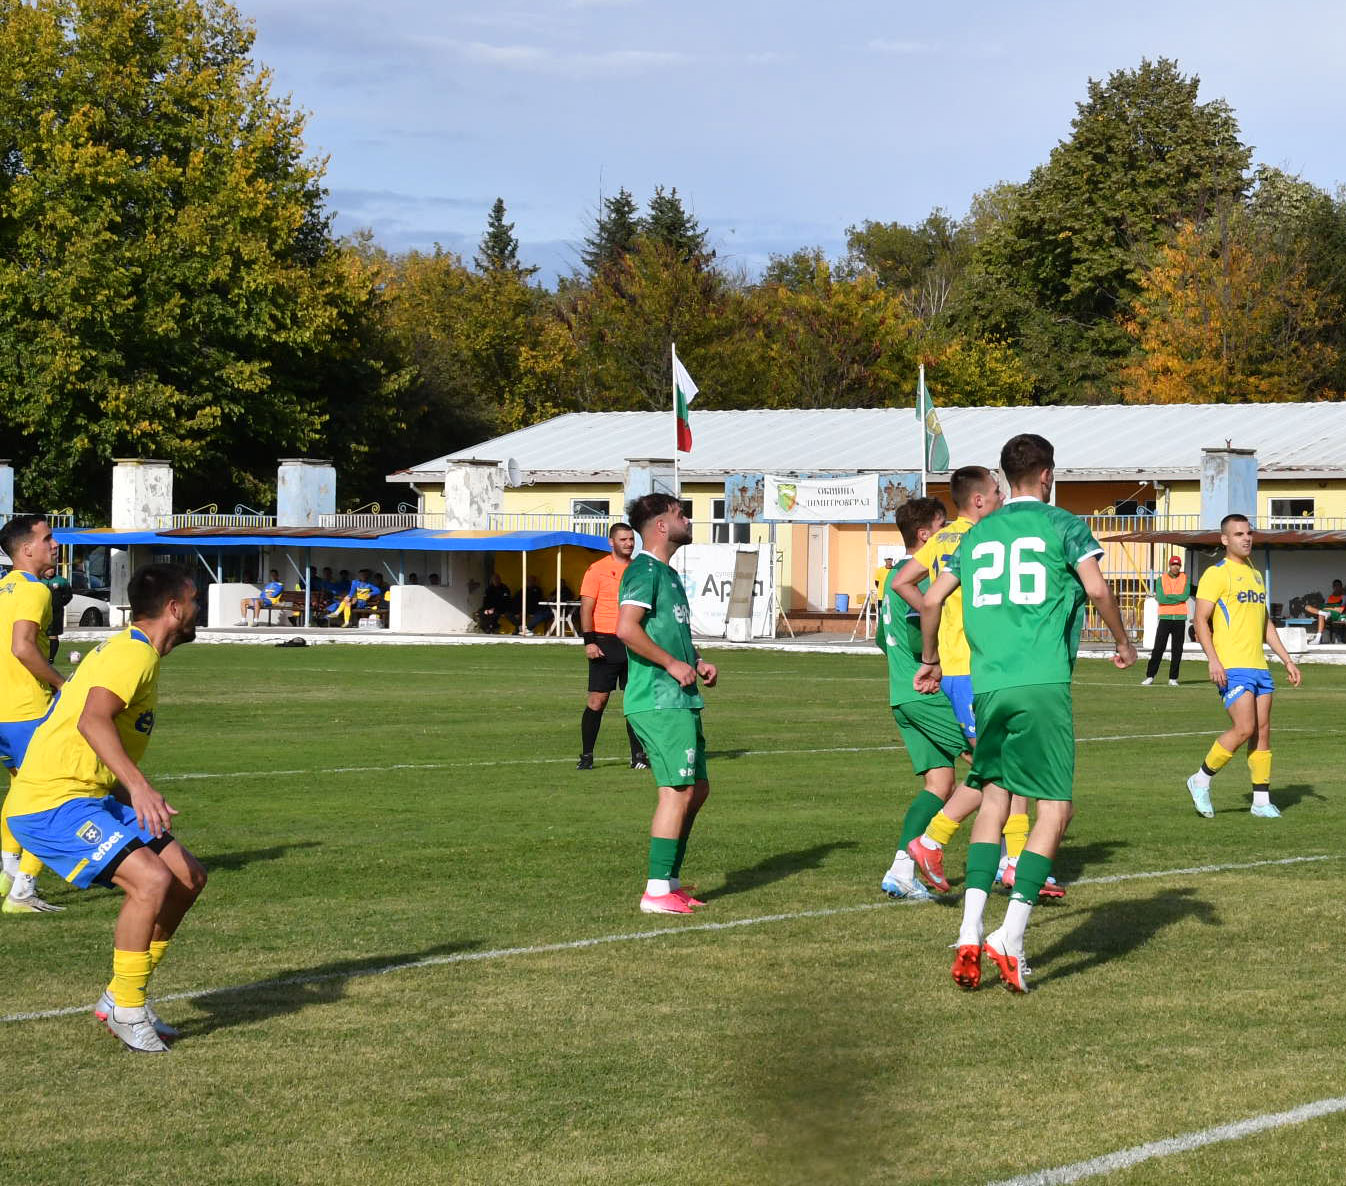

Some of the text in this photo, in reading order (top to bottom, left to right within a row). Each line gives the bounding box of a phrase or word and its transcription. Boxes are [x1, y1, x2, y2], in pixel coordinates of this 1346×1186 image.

[701, 573, 764, 602] Ара
[971, 536, 1047, 609] 26
[91, 831, 125, 861] efbet
